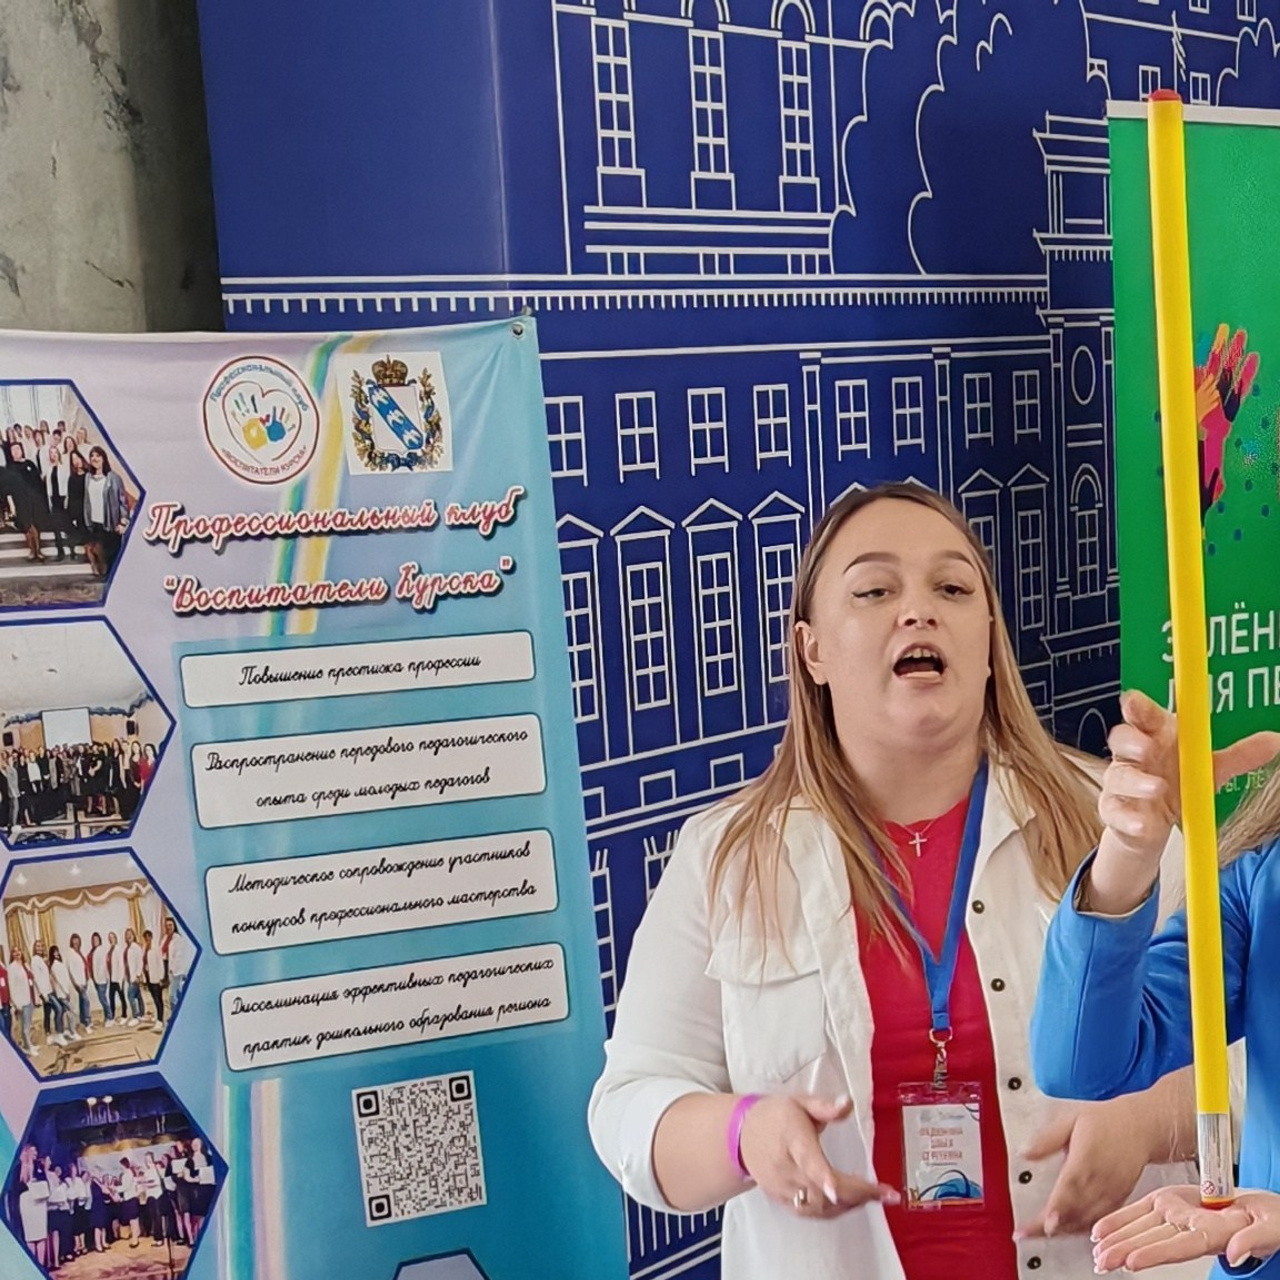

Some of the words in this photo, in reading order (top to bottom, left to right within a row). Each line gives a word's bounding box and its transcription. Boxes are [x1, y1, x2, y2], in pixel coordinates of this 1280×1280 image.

[143, 500, 438, 553] Профессиональный
[446, 486, 529, 536] клуб
[238, 666, 323, 686] Повышение
[328, 662, 404, 685] престижа
[408, 655, 481, 678] профессии
[204, 748, 336, 776] Распространение
[340, 736, 414, 765] передового
[418, 729, 528, 756] педагогического
[256, 793, 307, 808] опыта
[312, 788, 351, 809] среди
[354, 780, 420, 799] молодых
[424, 767, 491, 794] педагогов
[228, 868, 334, 895] Методическое
[339, 857, 444, 887] сопровождение
[448, 841, 531, 871] участников
[232, 908, 306, 936] конкурсов
[310, 895, 444, 929] профессионального
[447, 879, 536, 905] мастерства
[231, 989, 338, 1016] Диссеминация
[343, 972, 444, 1005] эффективных
[448, 958, 554, 986] педагогических
[243, 1034, 312, 1060] практик
[316, 1021, 404, 1052] дошкольного
[409, 1005, 493, 1036] образования
[498, 996, 551, 1023] региона
